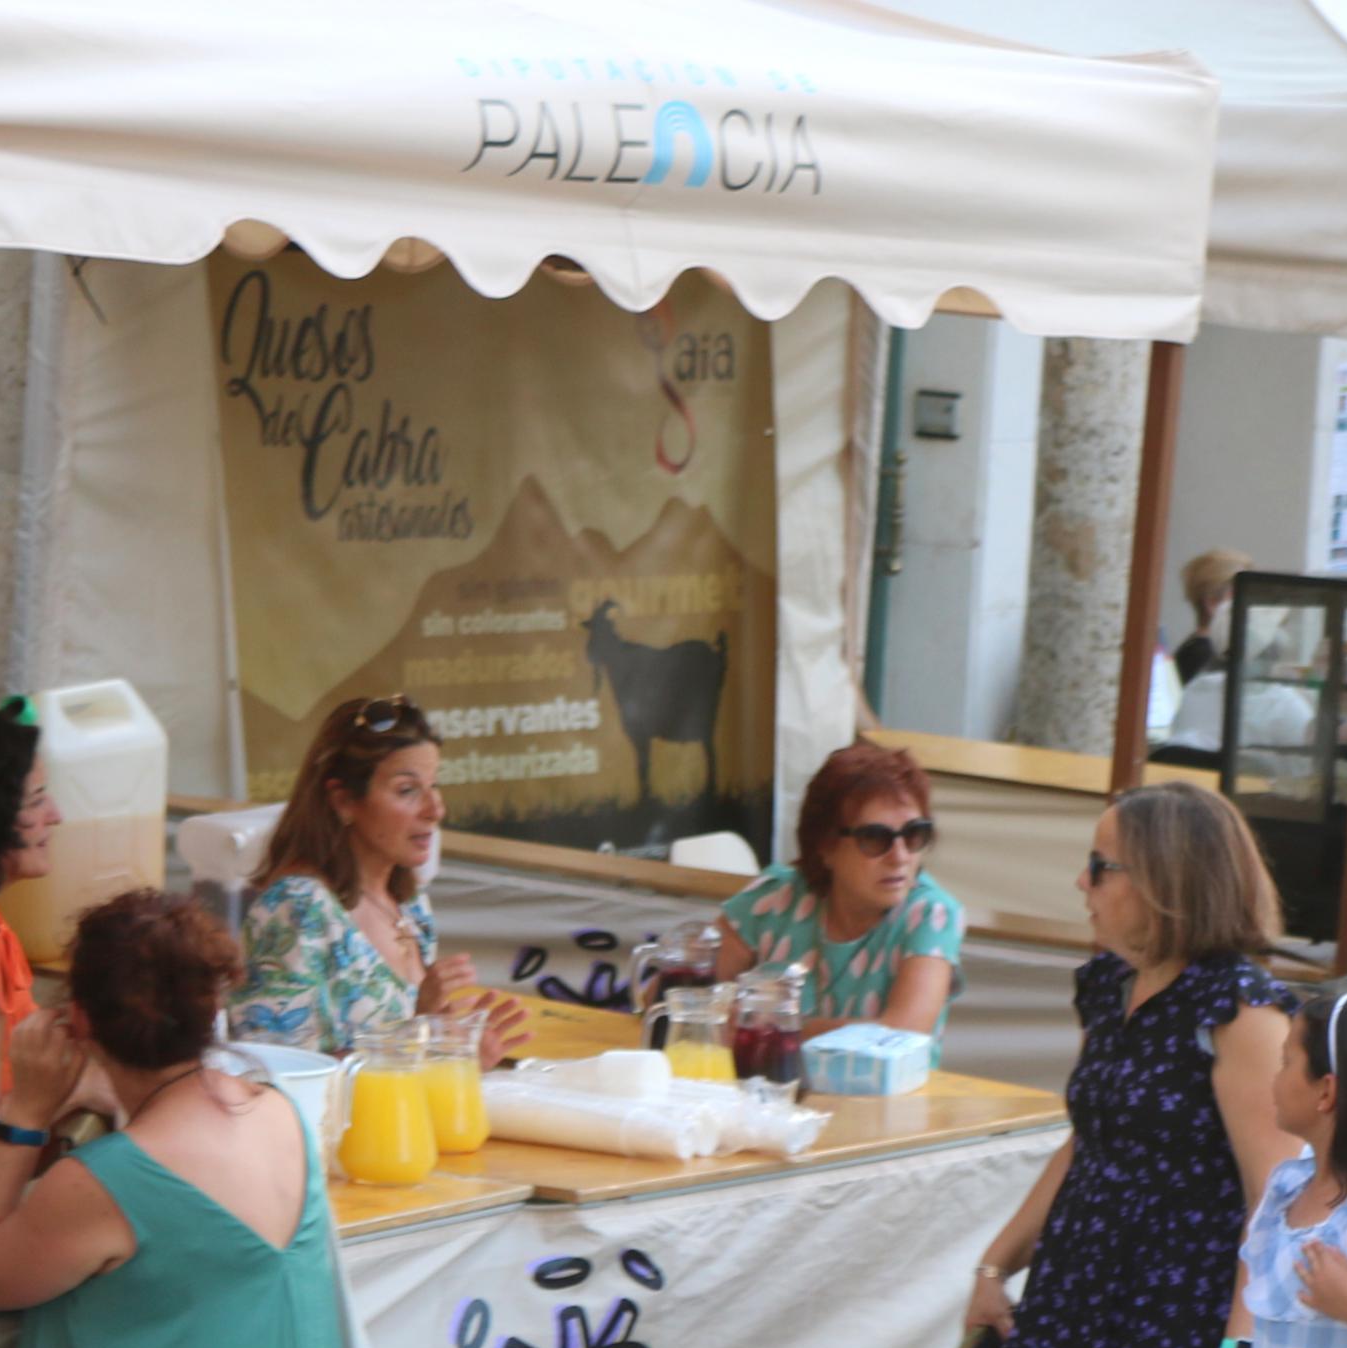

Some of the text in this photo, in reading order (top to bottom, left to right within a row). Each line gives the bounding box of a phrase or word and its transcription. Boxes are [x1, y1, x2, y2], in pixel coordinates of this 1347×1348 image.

[300, 381, 442, 521] Cabra
[421, 606, 567, 638] sin colorantes
[404, 647, 575, 687] madurados
[427, 696, 601, 740] nservantes
[438, 743, 600, 786] asteurizada
